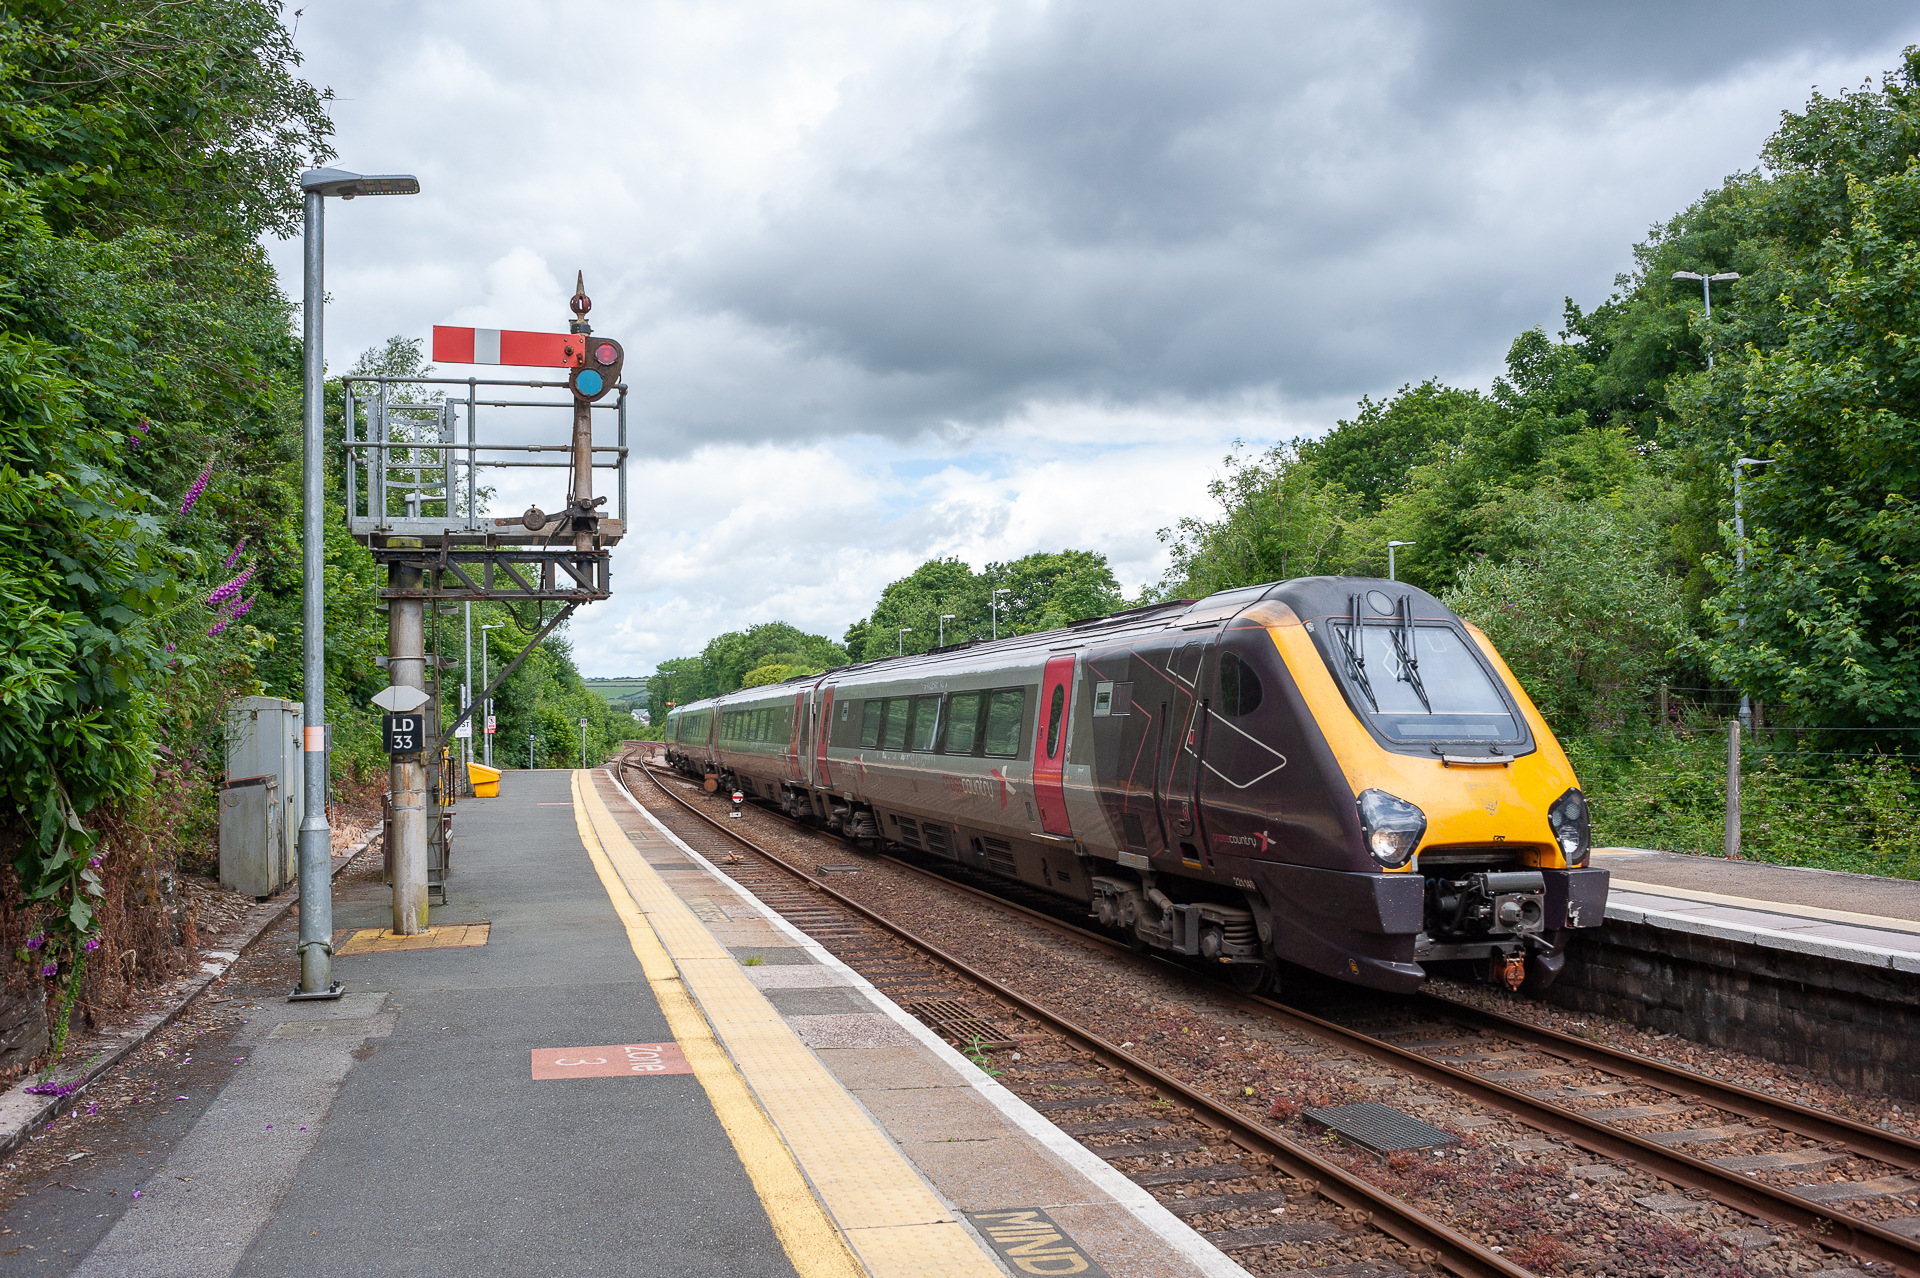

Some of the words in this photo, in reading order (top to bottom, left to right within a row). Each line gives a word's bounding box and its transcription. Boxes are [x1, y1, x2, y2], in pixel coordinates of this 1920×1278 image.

[392, 718, 415, 732] LD
[393, 735, 413, 749] 33
[555, 1057, 608, 1066] 3
[625, 1045, 666, 1072] Zone
[973, 1211, 1089, 1276] MIND
